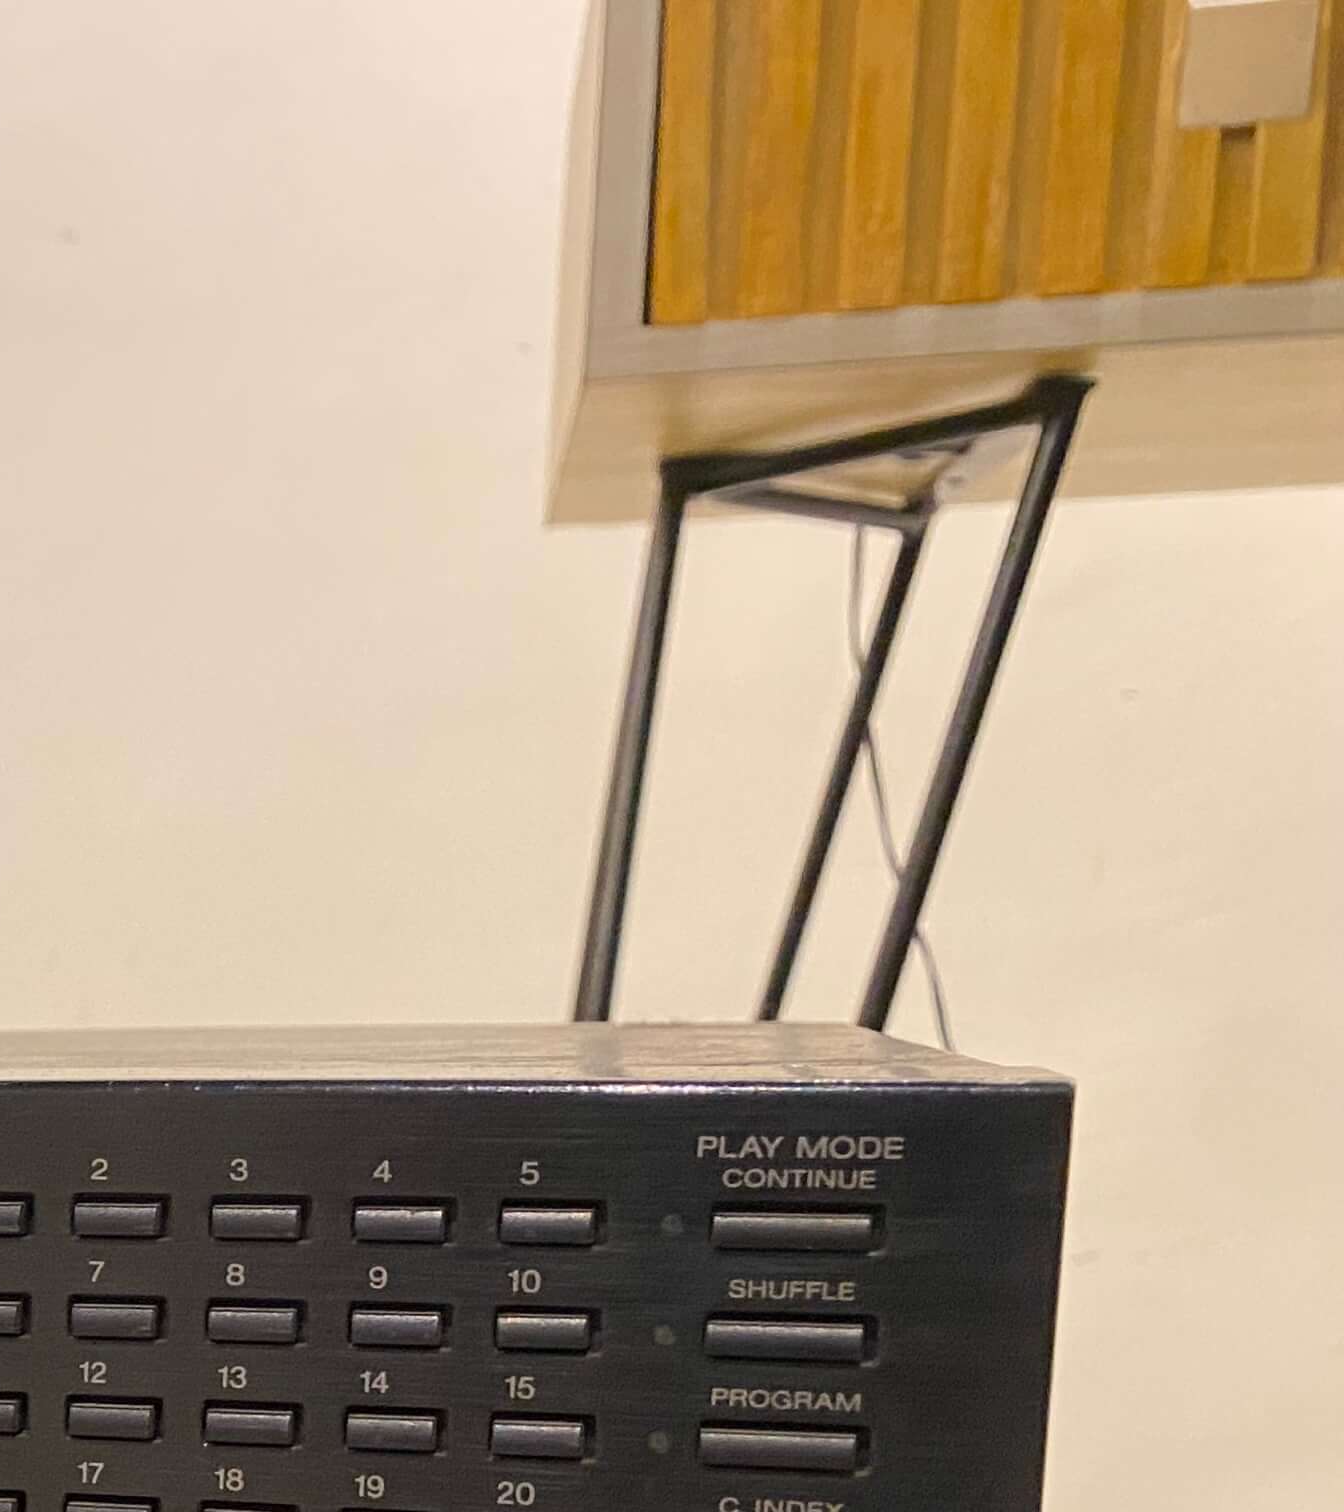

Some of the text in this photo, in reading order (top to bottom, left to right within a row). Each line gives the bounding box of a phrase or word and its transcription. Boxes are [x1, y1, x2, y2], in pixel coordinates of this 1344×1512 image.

[697, 1136, 905, 1160] PLAY MODE
[90, 1159, 108, 1181] 2
[228, 1159, 248, 1181] 3
[372, 1161, 392, 1183] 4
[519, 1162, 539, 1184] 5
[722, 1169, 876, 1189] CONTINUE
[88, 1261, 104, 1282] 7
[226, 1264, 245, 1286] 8
[368, 1267, 387, 1289] 9
[508, 1270, 541, 1293] 10
[728, 1280, 856, 1301] SHUFFLE
[80, 1362, 107, 1384] 12
[218, 1366, 247, 1389] 13
[360, 1371, 389, 1394] 14
[505, 1376, 535, 1399] 15
[711, 1388, 862, 1412] PROGRAM
[78, 1463, 104, 1484] 17
[214, 1468, 244, 1492] 18
[355, 1475, 384, 1498] 19
[497, 1482, 535, 1506] 20
